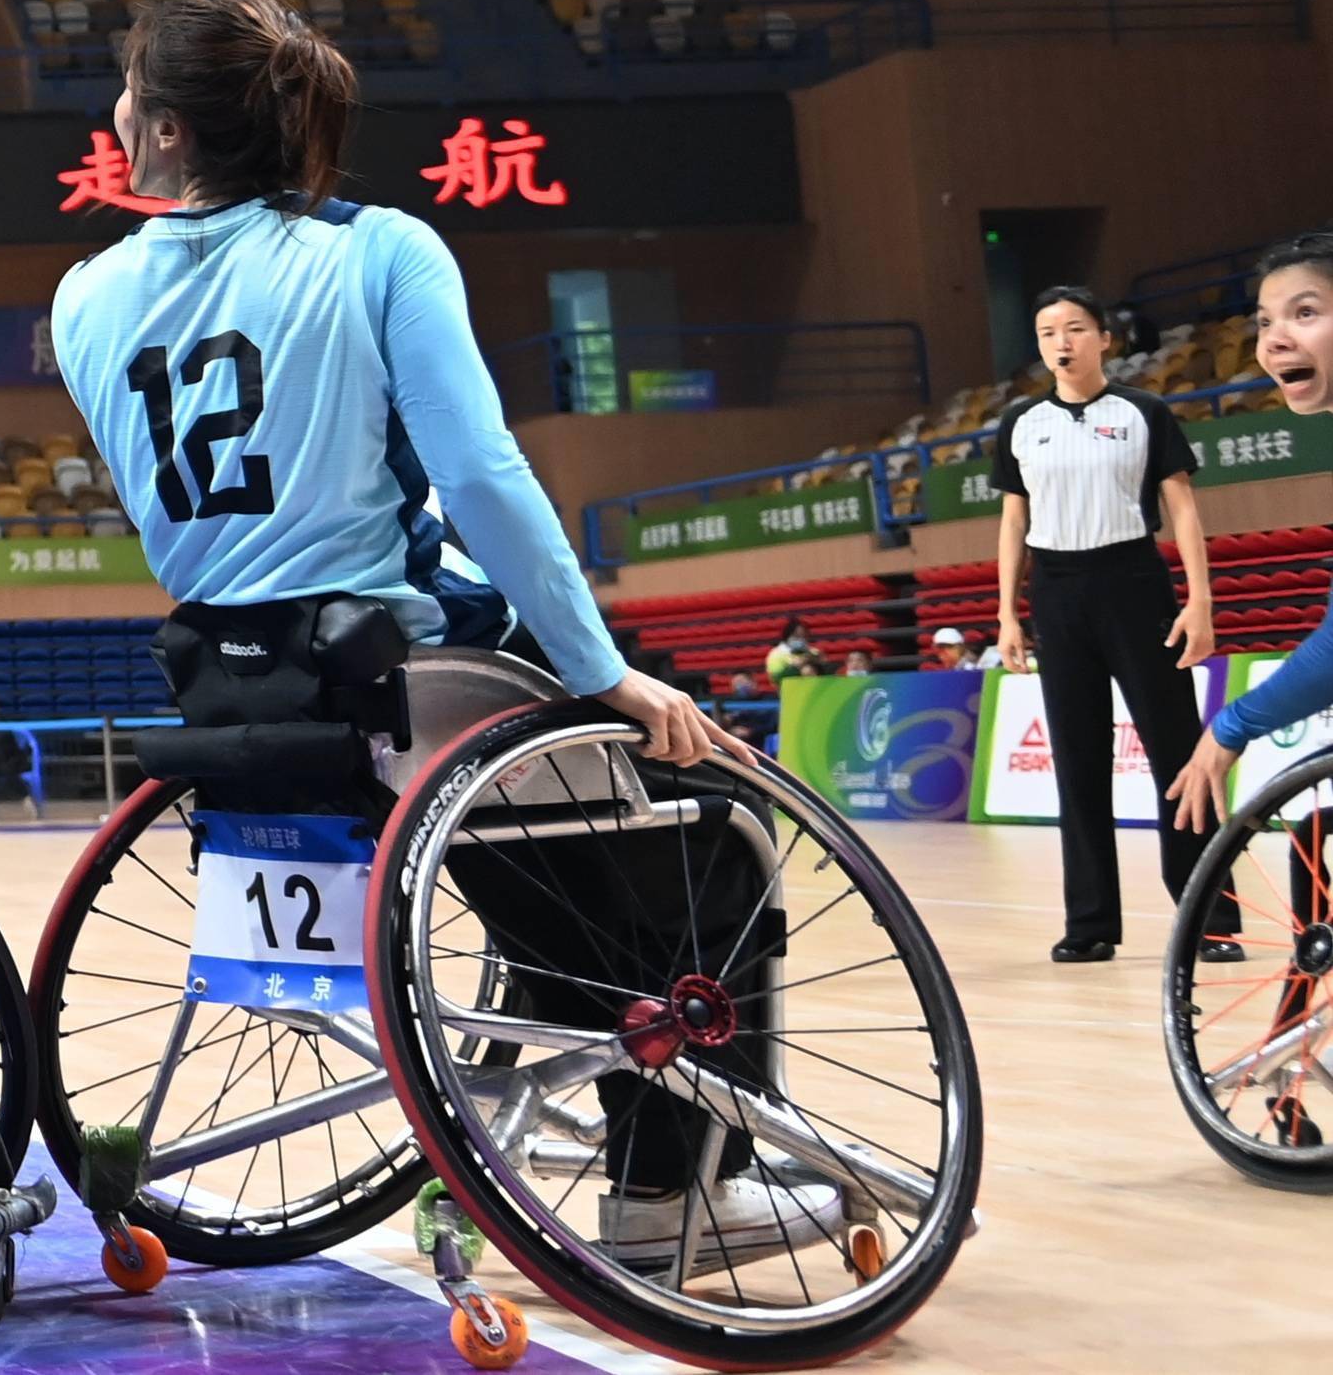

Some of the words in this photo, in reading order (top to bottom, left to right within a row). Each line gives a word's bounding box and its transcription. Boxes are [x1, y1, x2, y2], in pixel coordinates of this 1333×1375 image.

[420, 118, 567, 208] 航
[126, 328, 275, 524] 12
[240, 825, 302, 850] 轮椅篮球
[245, 871, 336, 952] 12
[263, 973, 334, 1002] 北京
